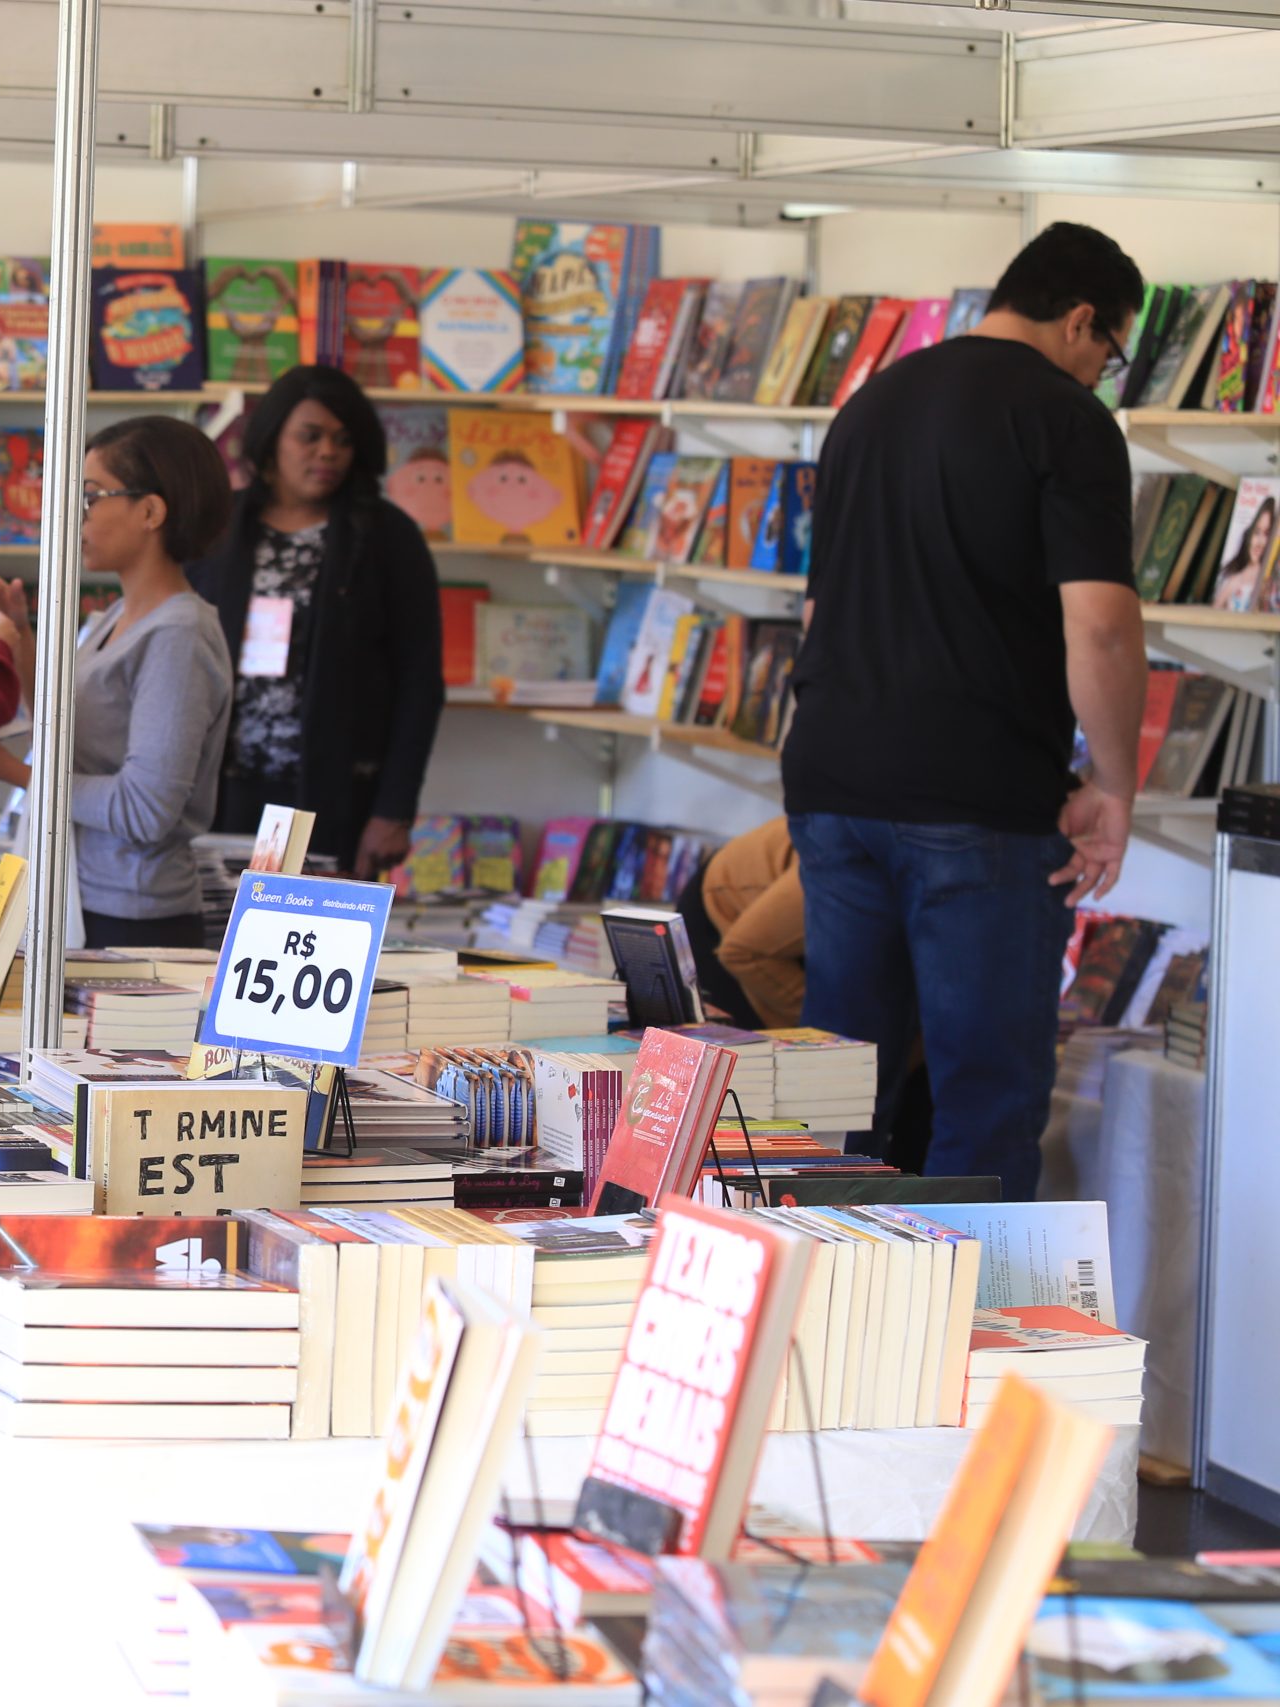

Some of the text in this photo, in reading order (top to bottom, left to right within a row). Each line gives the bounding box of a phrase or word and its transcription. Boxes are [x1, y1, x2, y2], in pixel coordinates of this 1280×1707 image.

[250, 891, 376, 913] Queen Books distribuindo ARTE
[283, 930, 317, 960] R$
[234, 957, 353, 1015] 15,00
[133, 1109, 153, 1140] T
[137, 1153, 241, 1197] EST
